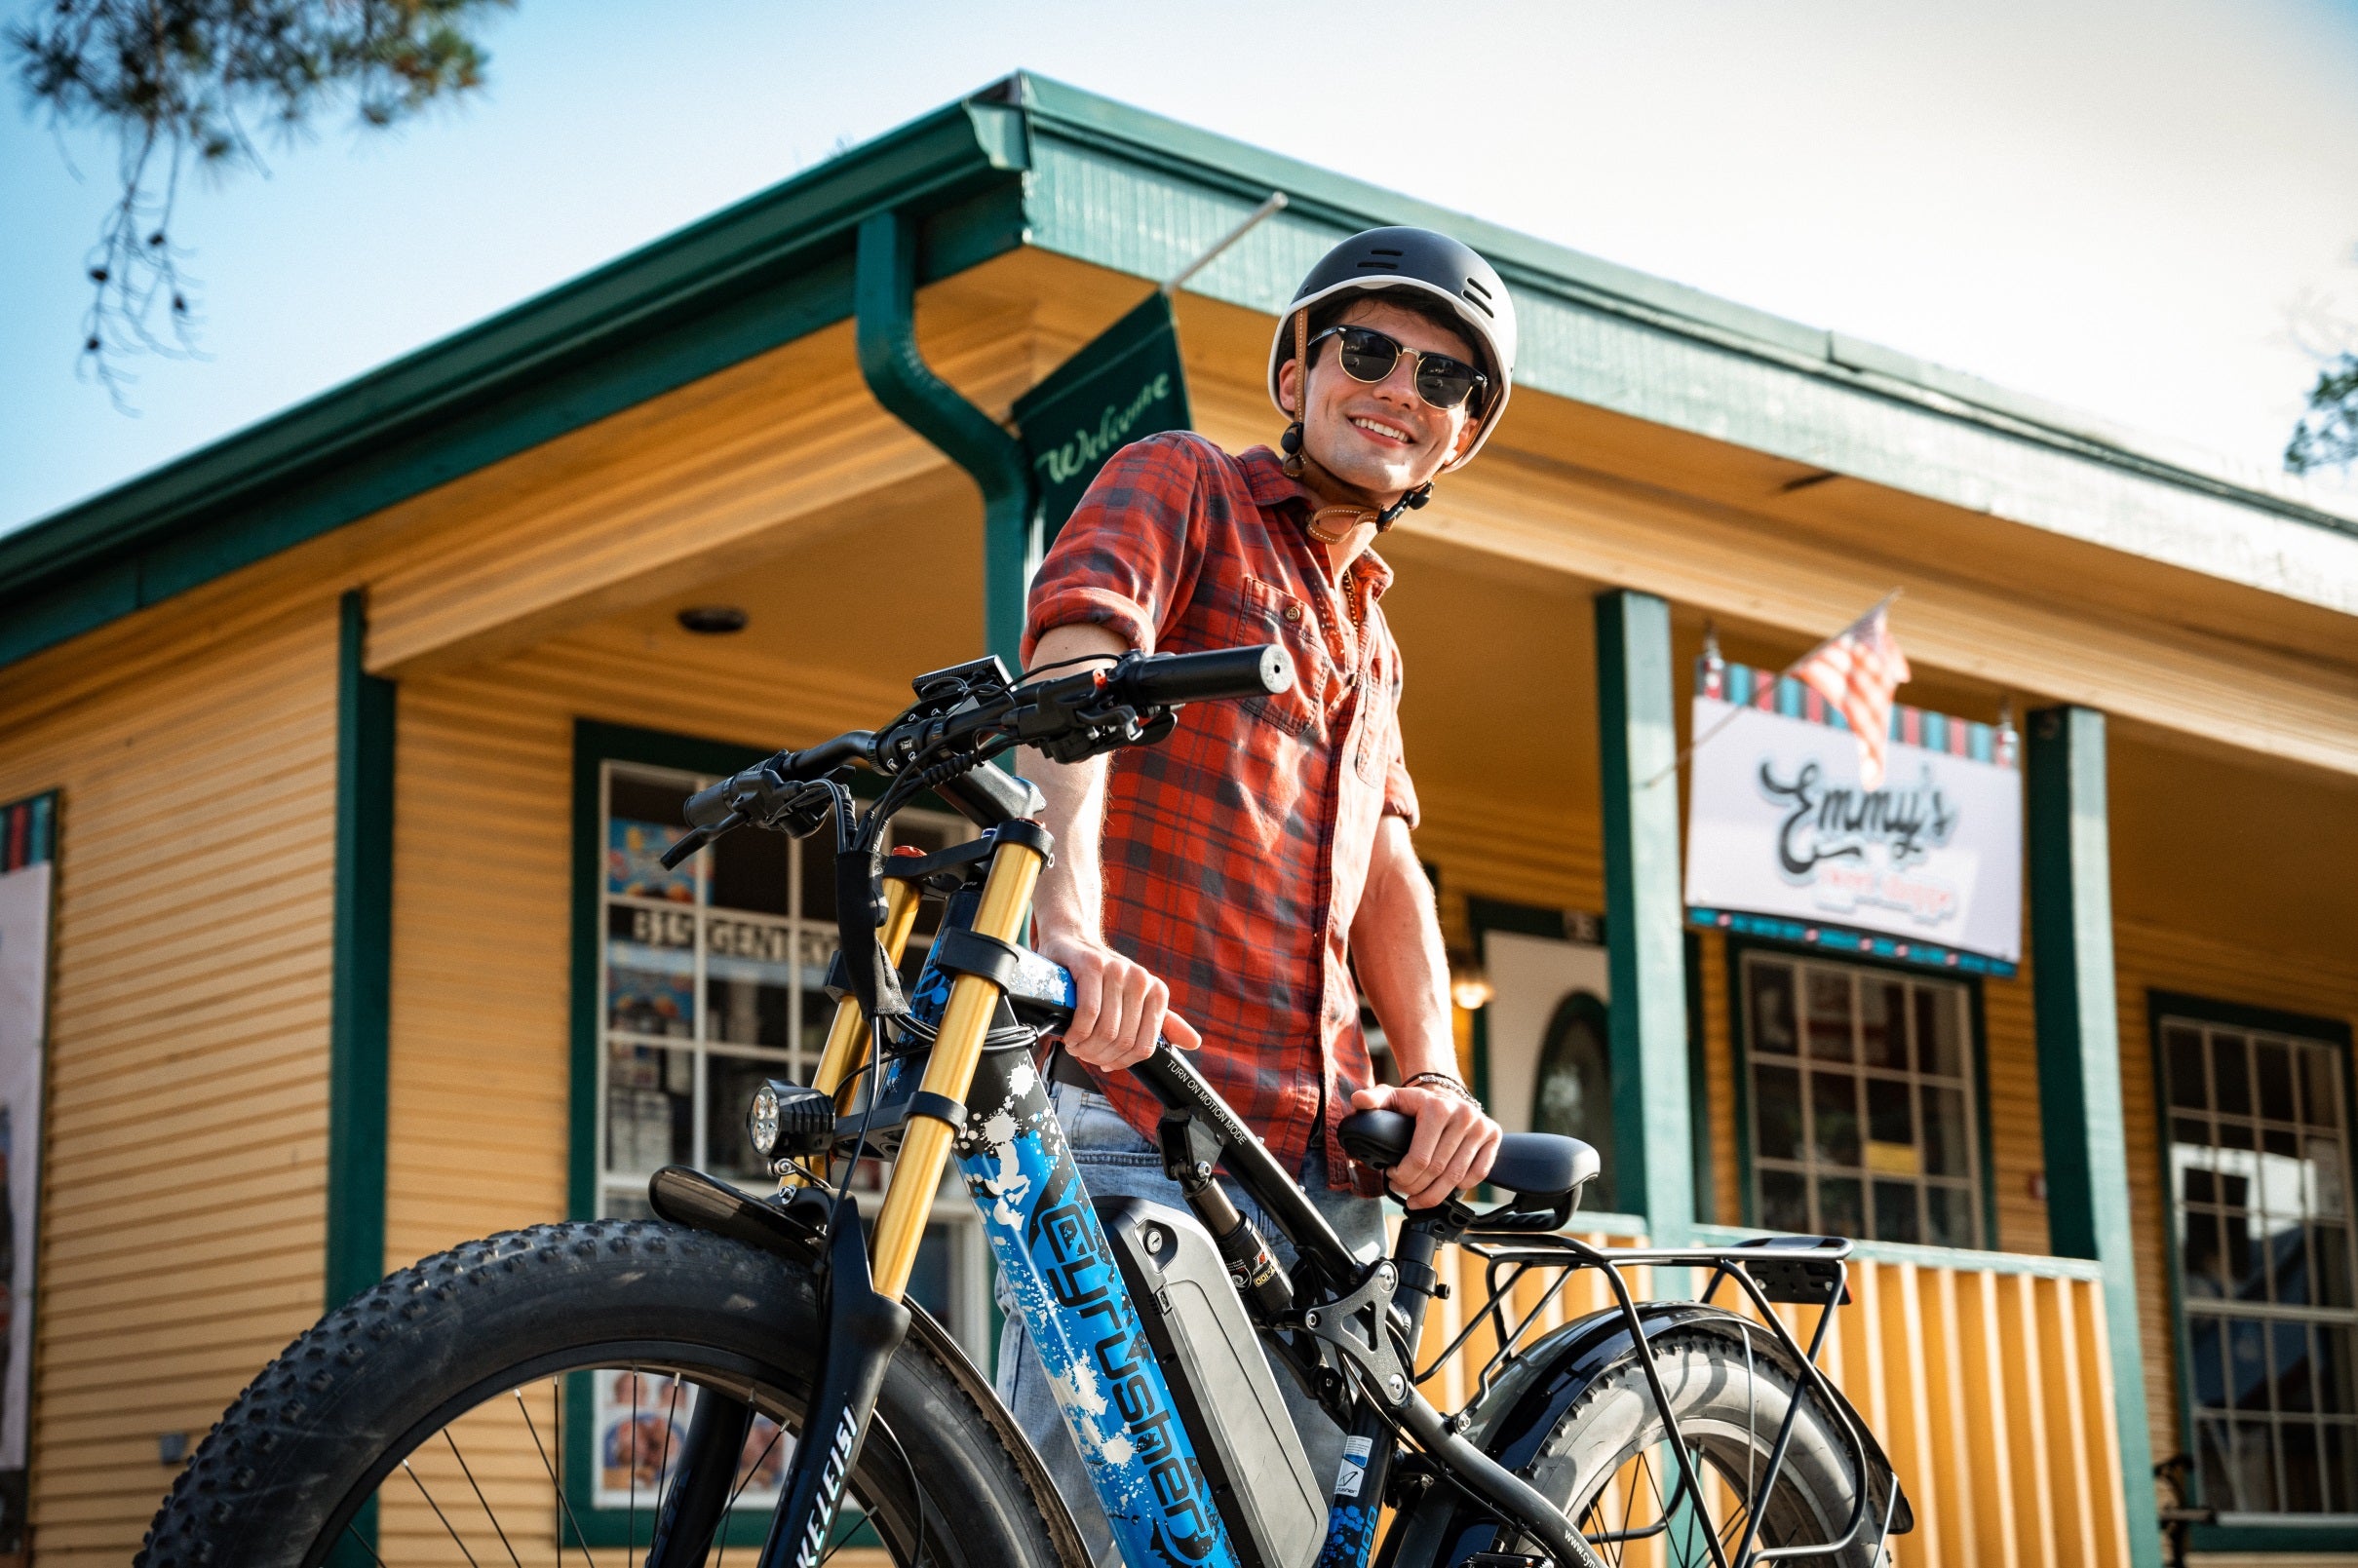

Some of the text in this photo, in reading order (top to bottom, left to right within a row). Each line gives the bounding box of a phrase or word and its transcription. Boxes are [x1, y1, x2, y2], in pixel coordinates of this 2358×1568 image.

[1033, 371, 1169, 484] Welcome
[1759, 759, 1952, 874] Emmy's
[1168, 1060, 1247, 1144] TURN ON MOTION MODE
[1564, 1529, 1600, 1568] www.cyr
